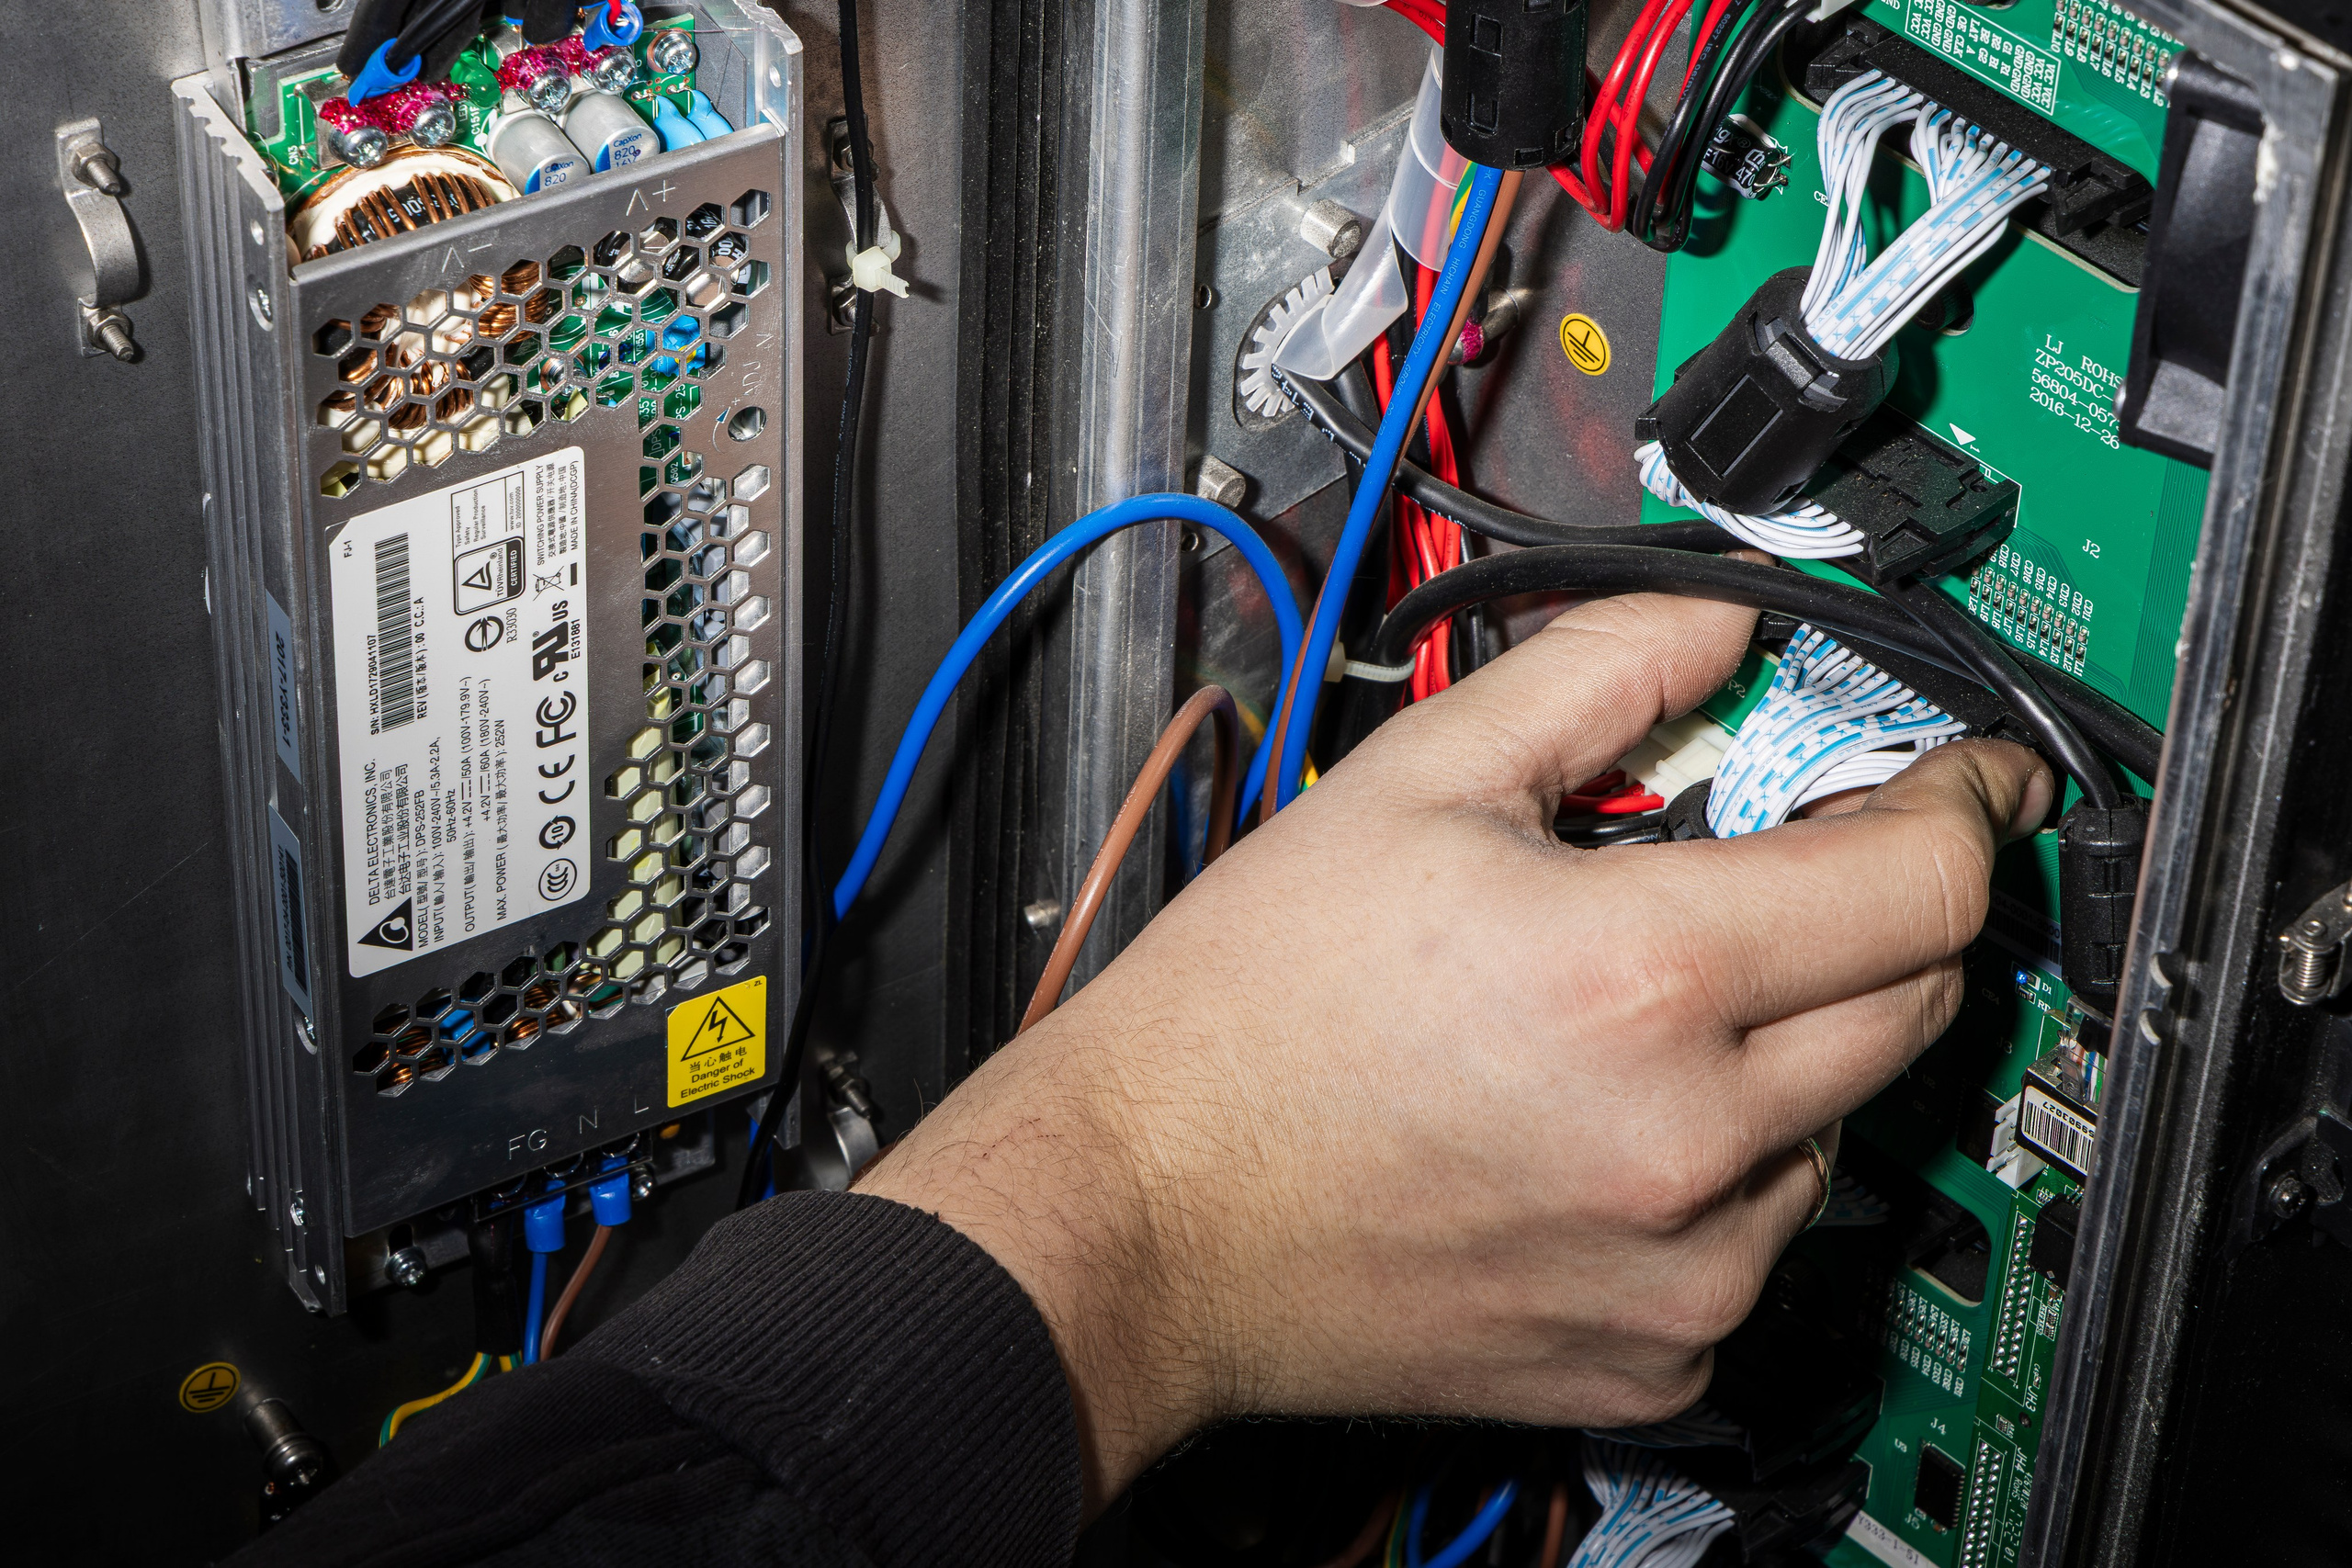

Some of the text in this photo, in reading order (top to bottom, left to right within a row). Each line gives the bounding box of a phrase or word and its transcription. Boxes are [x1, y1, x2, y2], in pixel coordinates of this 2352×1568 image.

[1713, 13, 1731, 41] 60227
[1910, 12, 1922, 34] VCC
[1920, 17, 1931, 39] VCC
[1931, 23, 1941, 47] GND
[1942, 5, 1957, 53] GND GND
[1953, 16, 1968, 58] OE CLK
[1966, 17, 1981, 55] LAT A
[2051, 30, 2063, 53] L10
[2064, 38, 2075, 57] L9
[1699, 42, 1713, 61] IEC
[2076, 44, 2088, 63] L8
[2089, 52, 2102, 72] L7
[2010, 44, 2025, 93] GND GND
[2020, 51, 2035, 98] GND GND
[2030, 57, 2045, 104] VCC VCC
[2101, 60, 2114, 78] L6
[2114, 67, 2127, 85] L5
[2041, 62, 2056, 109] VCC VCC
[2126, 73, 2140, 91] L4
[2140, 82, 2153, 99] L3
[2153, 88, 2165, 107] L2
[613, 132, 642, 148] CapXon
[288, 145, 299, 164] CN3
[614, 145, 636, 161] 820
[544, 172, 567, 186] 820
[1458, 189, 1487, 249] GUANGDONG
[1441, 257, 1461, 295] HICHAIN
[1412, 301, 1442, 357] ELECTRICITY
[2045, 333, 2064, 355] LJ
[1395, 364, 1411, 396] GROUP
[2030, 386, 2120, 450] 2016-12-26
[535, 465, 545, 566] SWITCHING POWER SUPPLY
[570, 460, 579, 551] MADE IN CHINA(DCGP)
[344, 539, 352, 558] FJ-1
[1998, 544, 2009, 569] CD18
[2082, 538, 2101, 558] J2
[510, 549, 518, 586] CERTIFIED
[2010, 552, 2021, 577] CD17
[2022, 559, 2034, 584] CD16
[2034, 567, 2046, 592] CD15
[2046, 576, 2058, 601] CD14
[2058, 582, 2070, 608] CD13
[2071, 591, 2083, 616] CD12
[551, 600, 569, 622] US
[1980, 604, 1990, 623] L19
[1991, 611, 2002, 630] L18
[2082, 599, 2094, 622] CD11
[506, 607, 517, 644] R33030
[2003, 617, 2014, 637] L17
[2015, 625, 2026, 643] L16
[571, 618, 581, 660] E131881
[2026, 631, 2038, 650] L15
[2038, 638, 2050, 658] L14
[2050, 646, 2062, 665] L13
[2063, 653, 2074, 672] L12
[2074, 660, 2085, 678] L11
[368, 635, 379, 735] S/N: HXLD1729041107
[417, 704, 427, 720] REV
[414, 789, 426, 847] DPS-252FB
[446, 788, 457, 842] 50Hz-60Hz
[494, 719, 507, 920] MAX. POWER 252W
[364, 759, 380, 905] DELTA ELECTRONICS, INC.
[395, 763, 412, 895] 台达电子工业股份有限公司
[2042, 983, 2052, 995] D1
[689, 1046, 747, 1074] 当心触电
[691, 1058, 744, 1083] Danger of
[681, 1067, 755, 1099] Electric Shock
[634, 1096, 650, 1114] L
[579, 1109, 598, 1134] N
[508, 1129, 548, 1160] FG
[2025, 1385, 2038, 1413] JH3
[1930, 1417, 1947, 1435] J4
[2014, 1447, 2028, 1473] JH4
